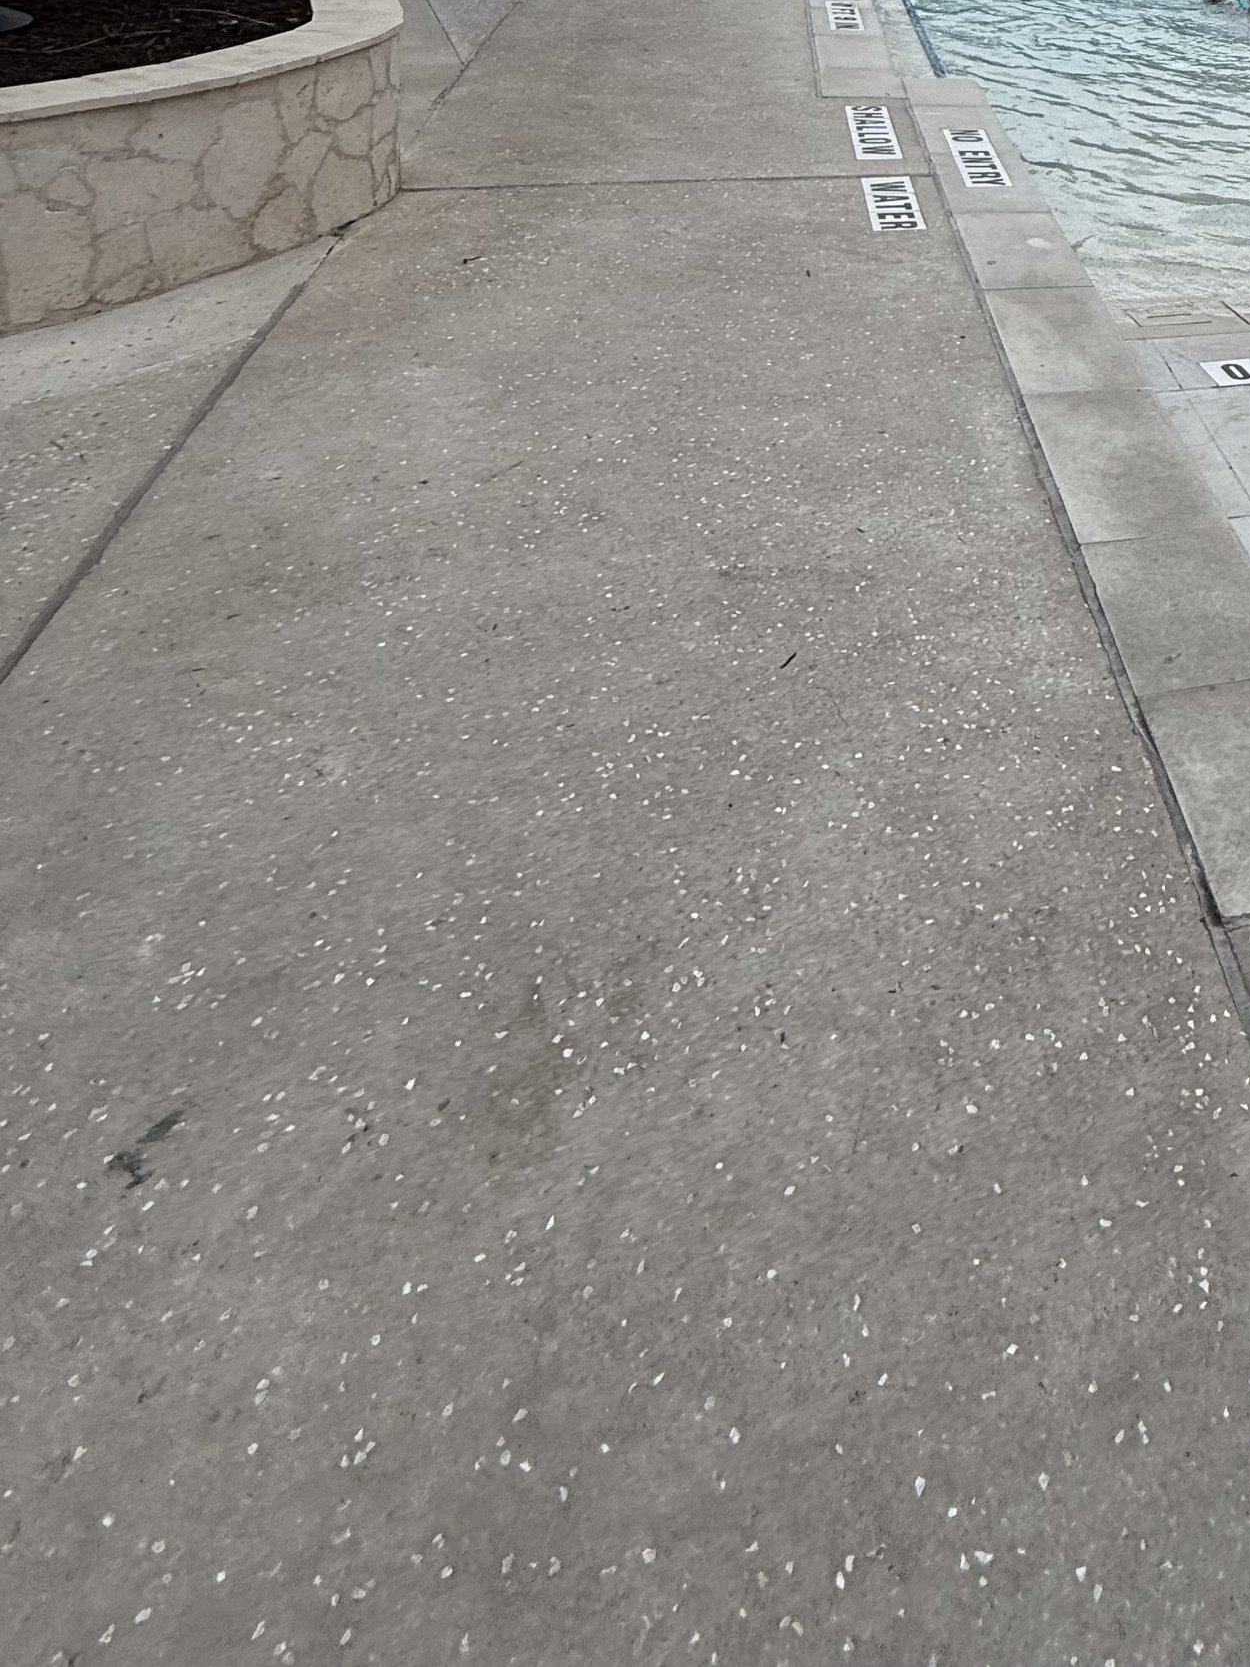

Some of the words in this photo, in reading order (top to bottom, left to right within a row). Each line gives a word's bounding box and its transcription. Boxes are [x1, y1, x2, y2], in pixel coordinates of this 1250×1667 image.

[851, 106, 896, 155] SHALLOW
[949, 129, 983, 142] NO
[958, 150, 1006, 185] ENTRY
[870, 181, 917, 229] WATER
